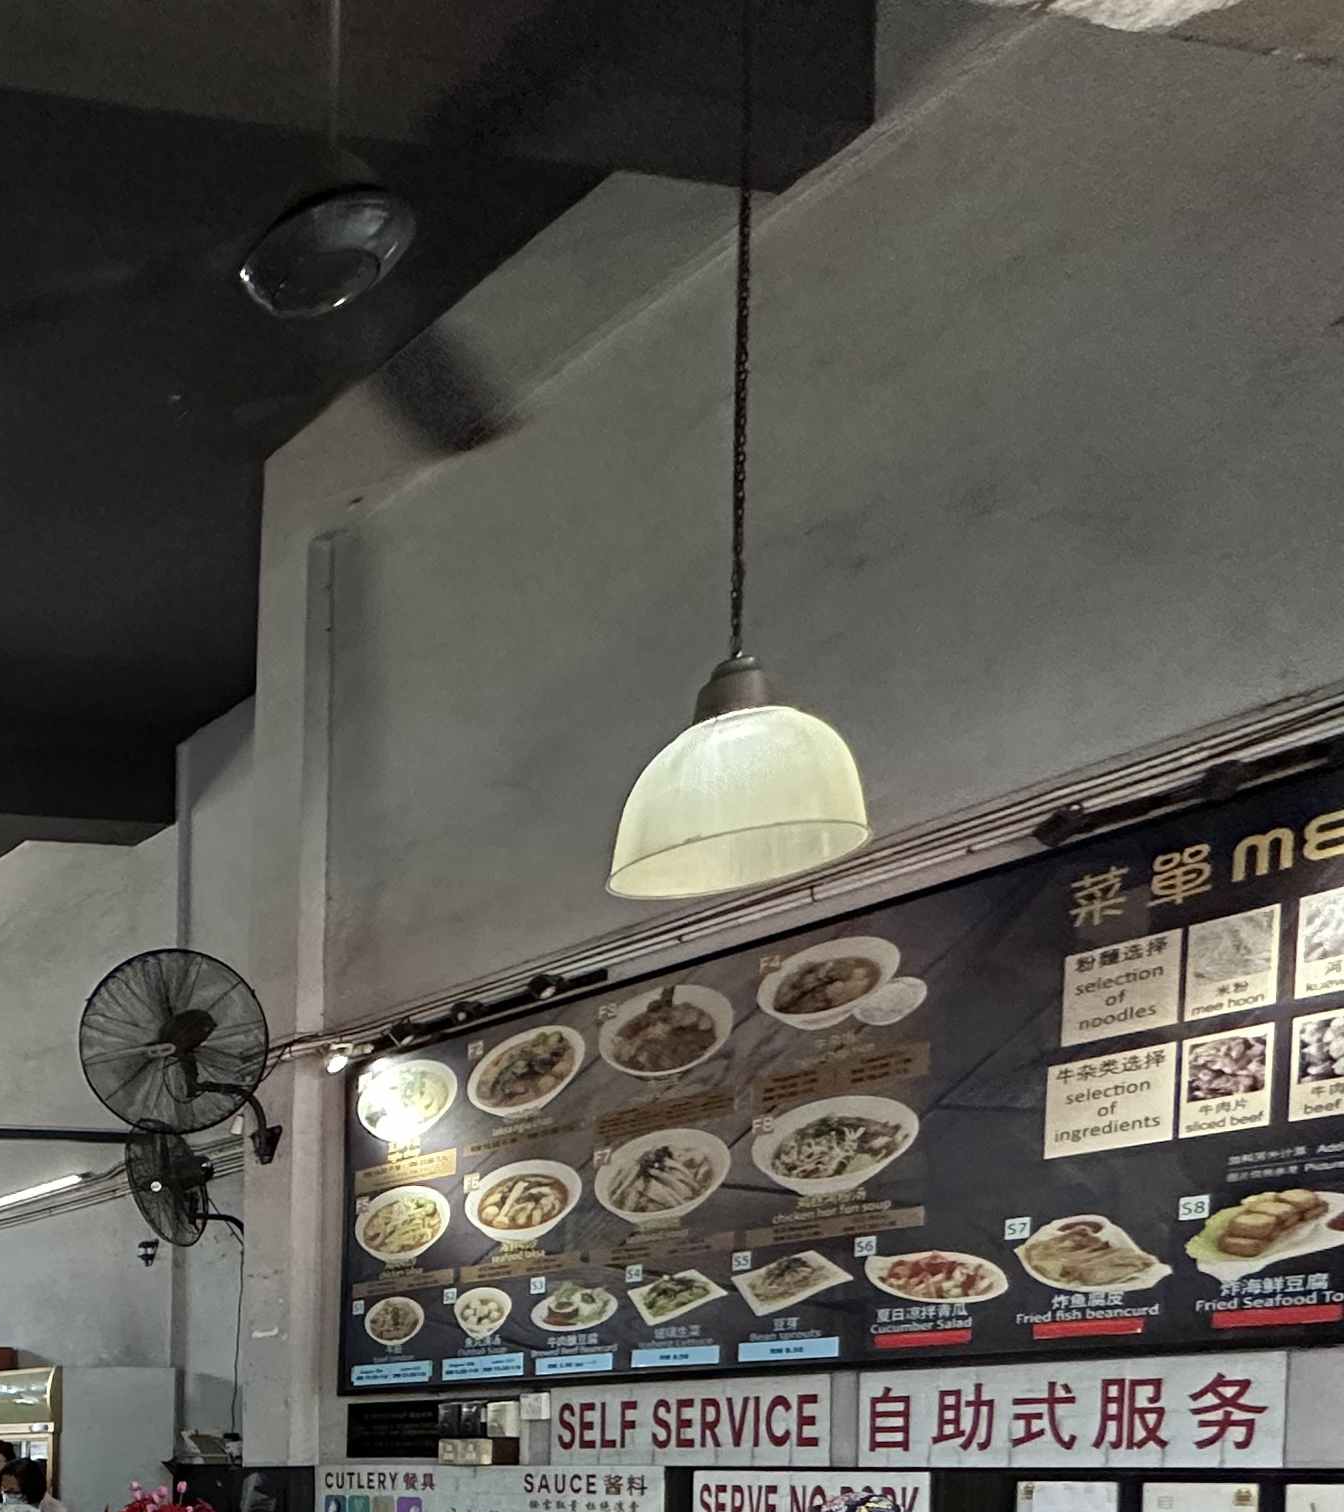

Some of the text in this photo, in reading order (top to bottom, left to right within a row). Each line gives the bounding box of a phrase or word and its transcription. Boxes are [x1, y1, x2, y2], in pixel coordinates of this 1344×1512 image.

[1069, 843, 1212, 927] 菜單
[1074, 965, 1165, 996] selection
[1105, 989, 1125, 1007] of
[1191, 992, 1265, 1016] mee hoon
[1078, 1004, 1157, 1032] noodles
[1065, 1078, 1151, 1106] selection
[1097, 1101, 1117, 1118] of
[1054, 1115, 1161, 1143] ingredients
[1185, 1110, 1264, 1132] sliced beef
[1181, 1200, 1205, 1216] S8
[1007, 1222, 1026, 1236] S7
[857, 1240, 874, 1252] S6
[1195, 1297, 1240, 1312] Fried
[1243, 1292, 1318, 1309] Seafood
[1016, 1304, 1160, 1325] Fried fish beancurd
[871, 1317, 973, 1335] Cucumber Salad
[557, 1393, 820, 1450] SELF SERVICE
[868, 1372, 1269, 1452] 自助式服务
[324, 1472, 436, 1491] CUTLERY 餐具
[523, 1474, 597, 1494] SAUCE
